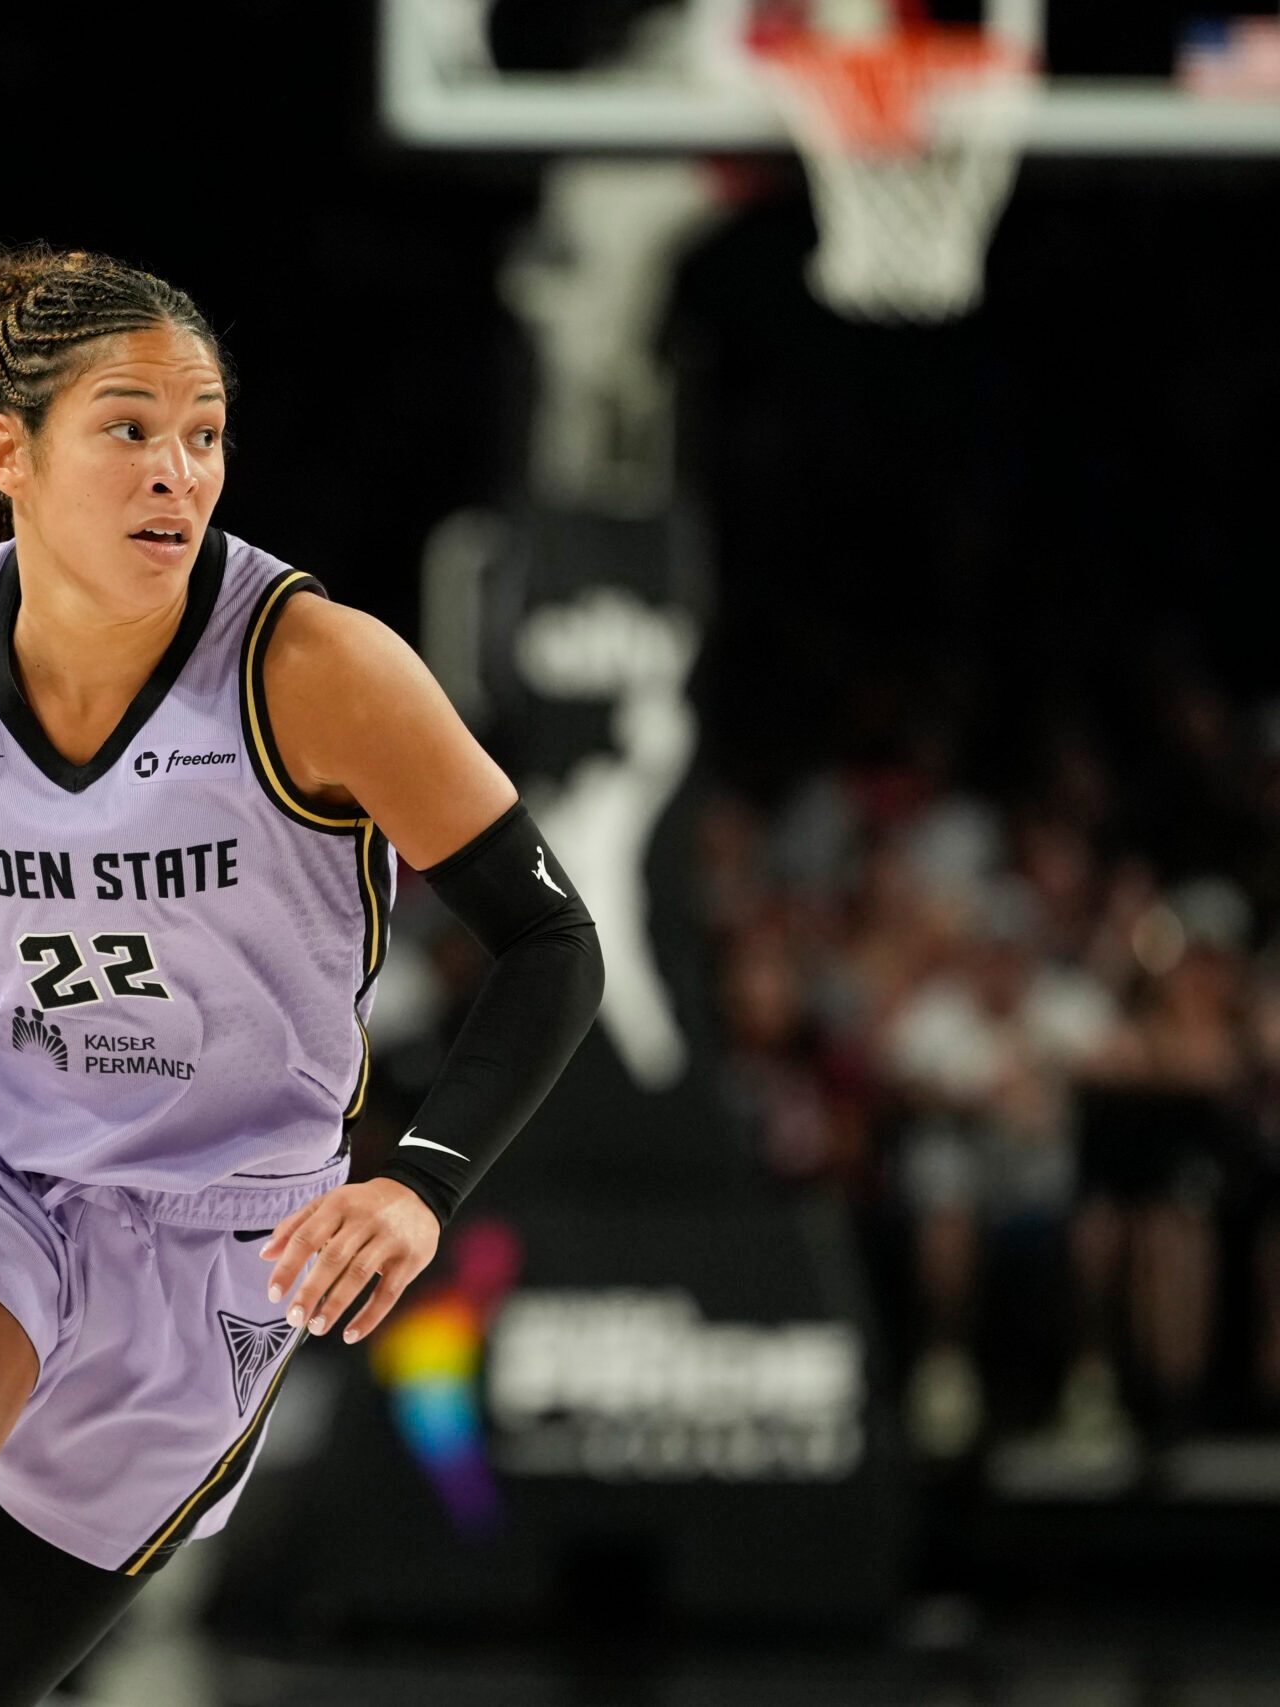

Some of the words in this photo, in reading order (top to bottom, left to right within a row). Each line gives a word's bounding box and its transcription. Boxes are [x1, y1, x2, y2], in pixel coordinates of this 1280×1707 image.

[165, 749, 236, 773] freedom
[93, 838, 238, 900] STATE
[16, 931, 174, 1012] 22
[84, 1034, 156, 1052] KAISER
